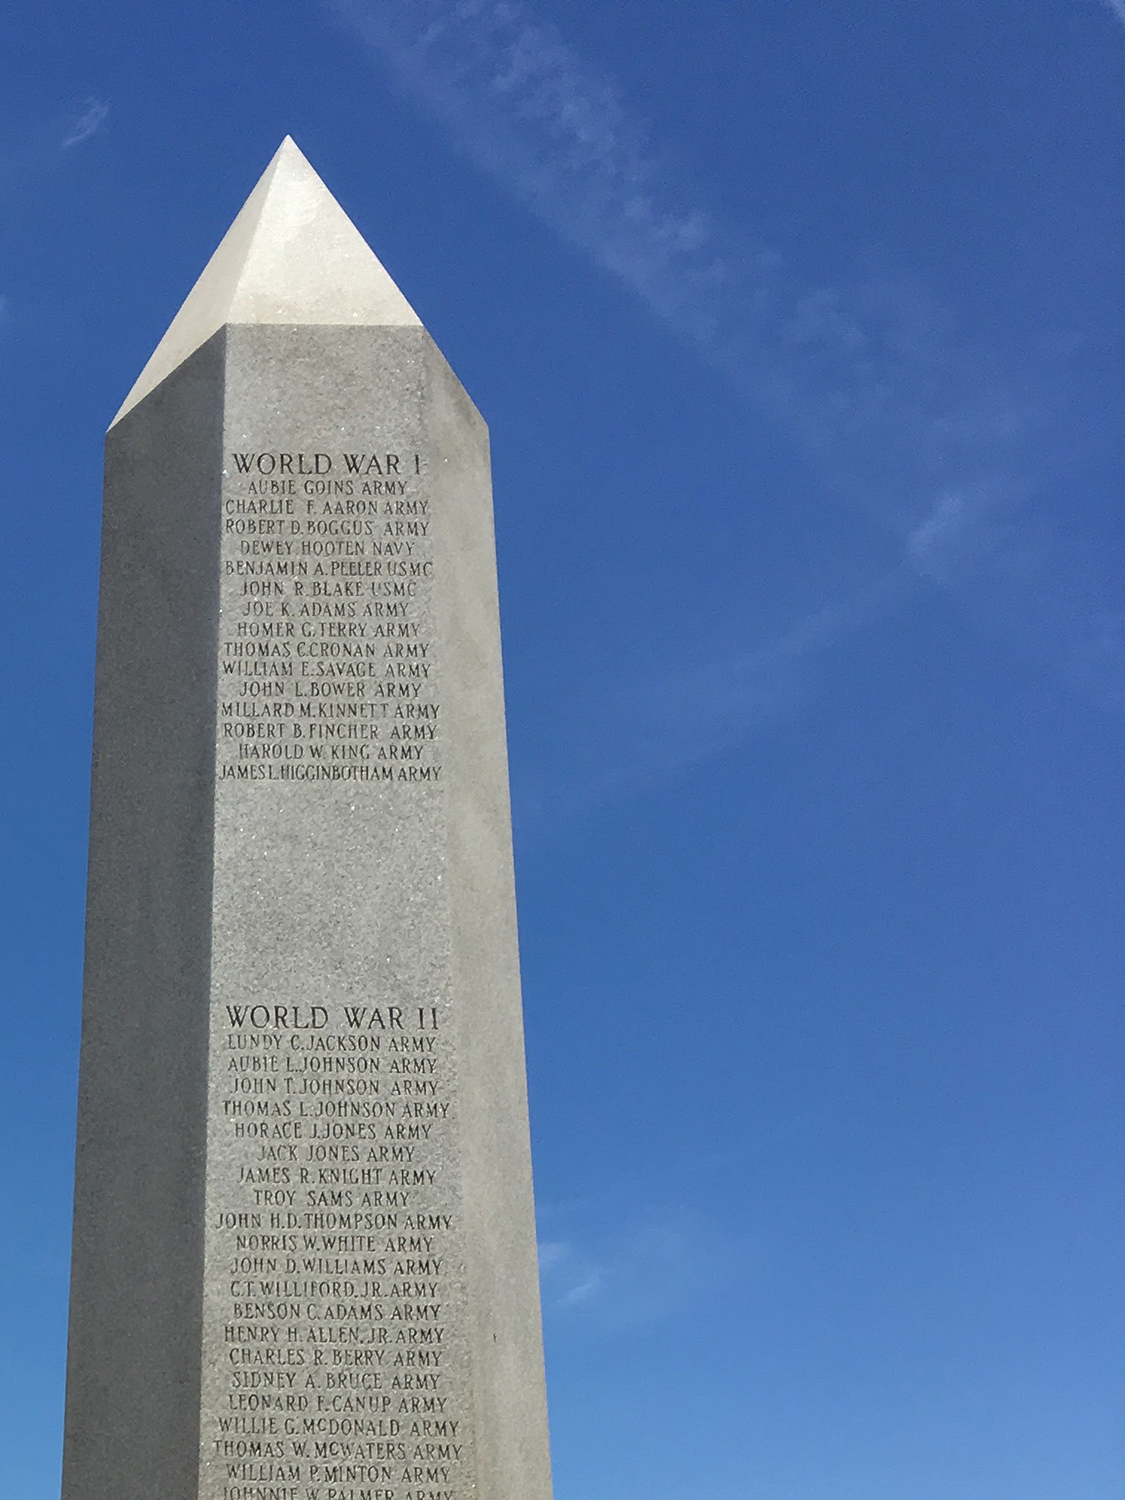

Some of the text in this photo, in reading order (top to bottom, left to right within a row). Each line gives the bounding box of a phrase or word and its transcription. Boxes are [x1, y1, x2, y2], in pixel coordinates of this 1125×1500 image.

[234, 453, 332, 475] WORLD
[343, 454, 401, 475] WAR
[248, 481, 407, 495] AUBIE GOINS ARMY
[226, 500, 428, 515] CHARLIE AARON ARMY
[225, 520, 285, 534] ROBERT
[384, 522, 429, 536] ARMY
[241, 541, 414, 556] DEWEY HOOTEN NAVY
[226, 561, 307, 575] BENJAMIN
[387, 562, 433, 577] USMC
[240, 582, 284, 596] JOHN
[371, 582, 417, 597] USMC
[243, 602, 409, 617] JOE ADAMS ARMY
[237, 622, 294, 636] HOMER
[374, 623, 420, 638] ARMY
[224, 642, 429, 658] THOMAS ARMY
[223, 661, 293, 676] WILLIAM
[385, 663, 431, 678] ARMY
[240, 682, 284, 697] JOHN
[375, 683, 421, 698] ARMY
[221, 702, 294, 717] MILLARD
[394, 704, 439, 719] ARMY
[224, 723, 285, 738] ROBERT
[390, 725, 437, 740] ARMY
[239, 744, 423, 760] HAROLD KING ARMY
[219, 765, 442, 781] JAMES ARMY
[226, 1005, 439, 1030] WORLD WAR II
[389, 1037, 436, 1052] ARMY
[228, 1057, 437, 1074] AUBIE ARMY
[230, 1079, 440, 1095] JOHN ARMY
[222, 1101, 450, 1118] THOMAS ARMY
[235, 1123, 432, 1139] HORACE ARMY
[257, 1145, 414, 1162] JACK JONES ARMY
[237, 1168, 436, 1185] JAMES ARMY
[254, 1190, 410, 1207] TROY SAMS ARMY
[216, 1213, 452, 1230] JOHN ARMY
[237, 1235, 433, 1253] NORRIS ARMY
[230, 1258, 443, 1275] JOHN ARMY
[390, 1282, 438, 1298] ARMY
[234, 1303, 440, 1321] BENSON ADAMS ARMY
[225, 1326, 445, 1344] HENRY ARMY
[229, 1349, 442, 1367] CHARLES ARMY
[232, 1372, 441, 1390] SIDNEY ARMY
[229, 1395, 447, 1413] LEONARD ARMY
[218, 1418, 459, 1437] WILLIE ARMY
[214, 1441, 463, 1461] THOMAS ARMY
[226, 1464, 451, 1483] WILLIAM ARMY
